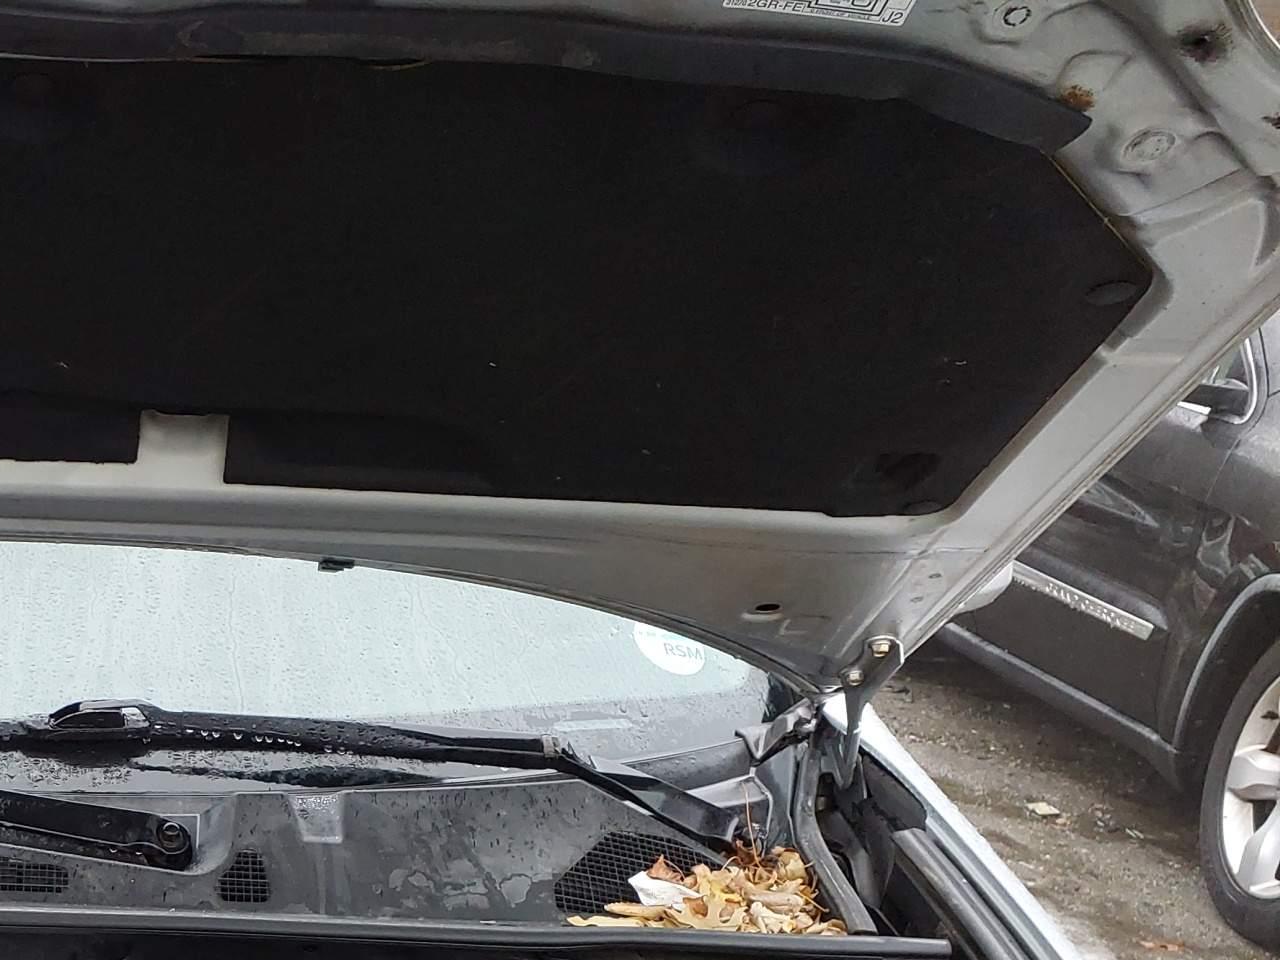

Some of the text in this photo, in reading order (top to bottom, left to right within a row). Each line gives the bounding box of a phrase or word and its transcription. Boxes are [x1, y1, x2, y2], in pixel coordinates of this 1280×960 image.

[748, 0, 804, 12] 2GR-FE
[881, 10, 904, 24] J2
[663, 642, 703, 661] RSM
